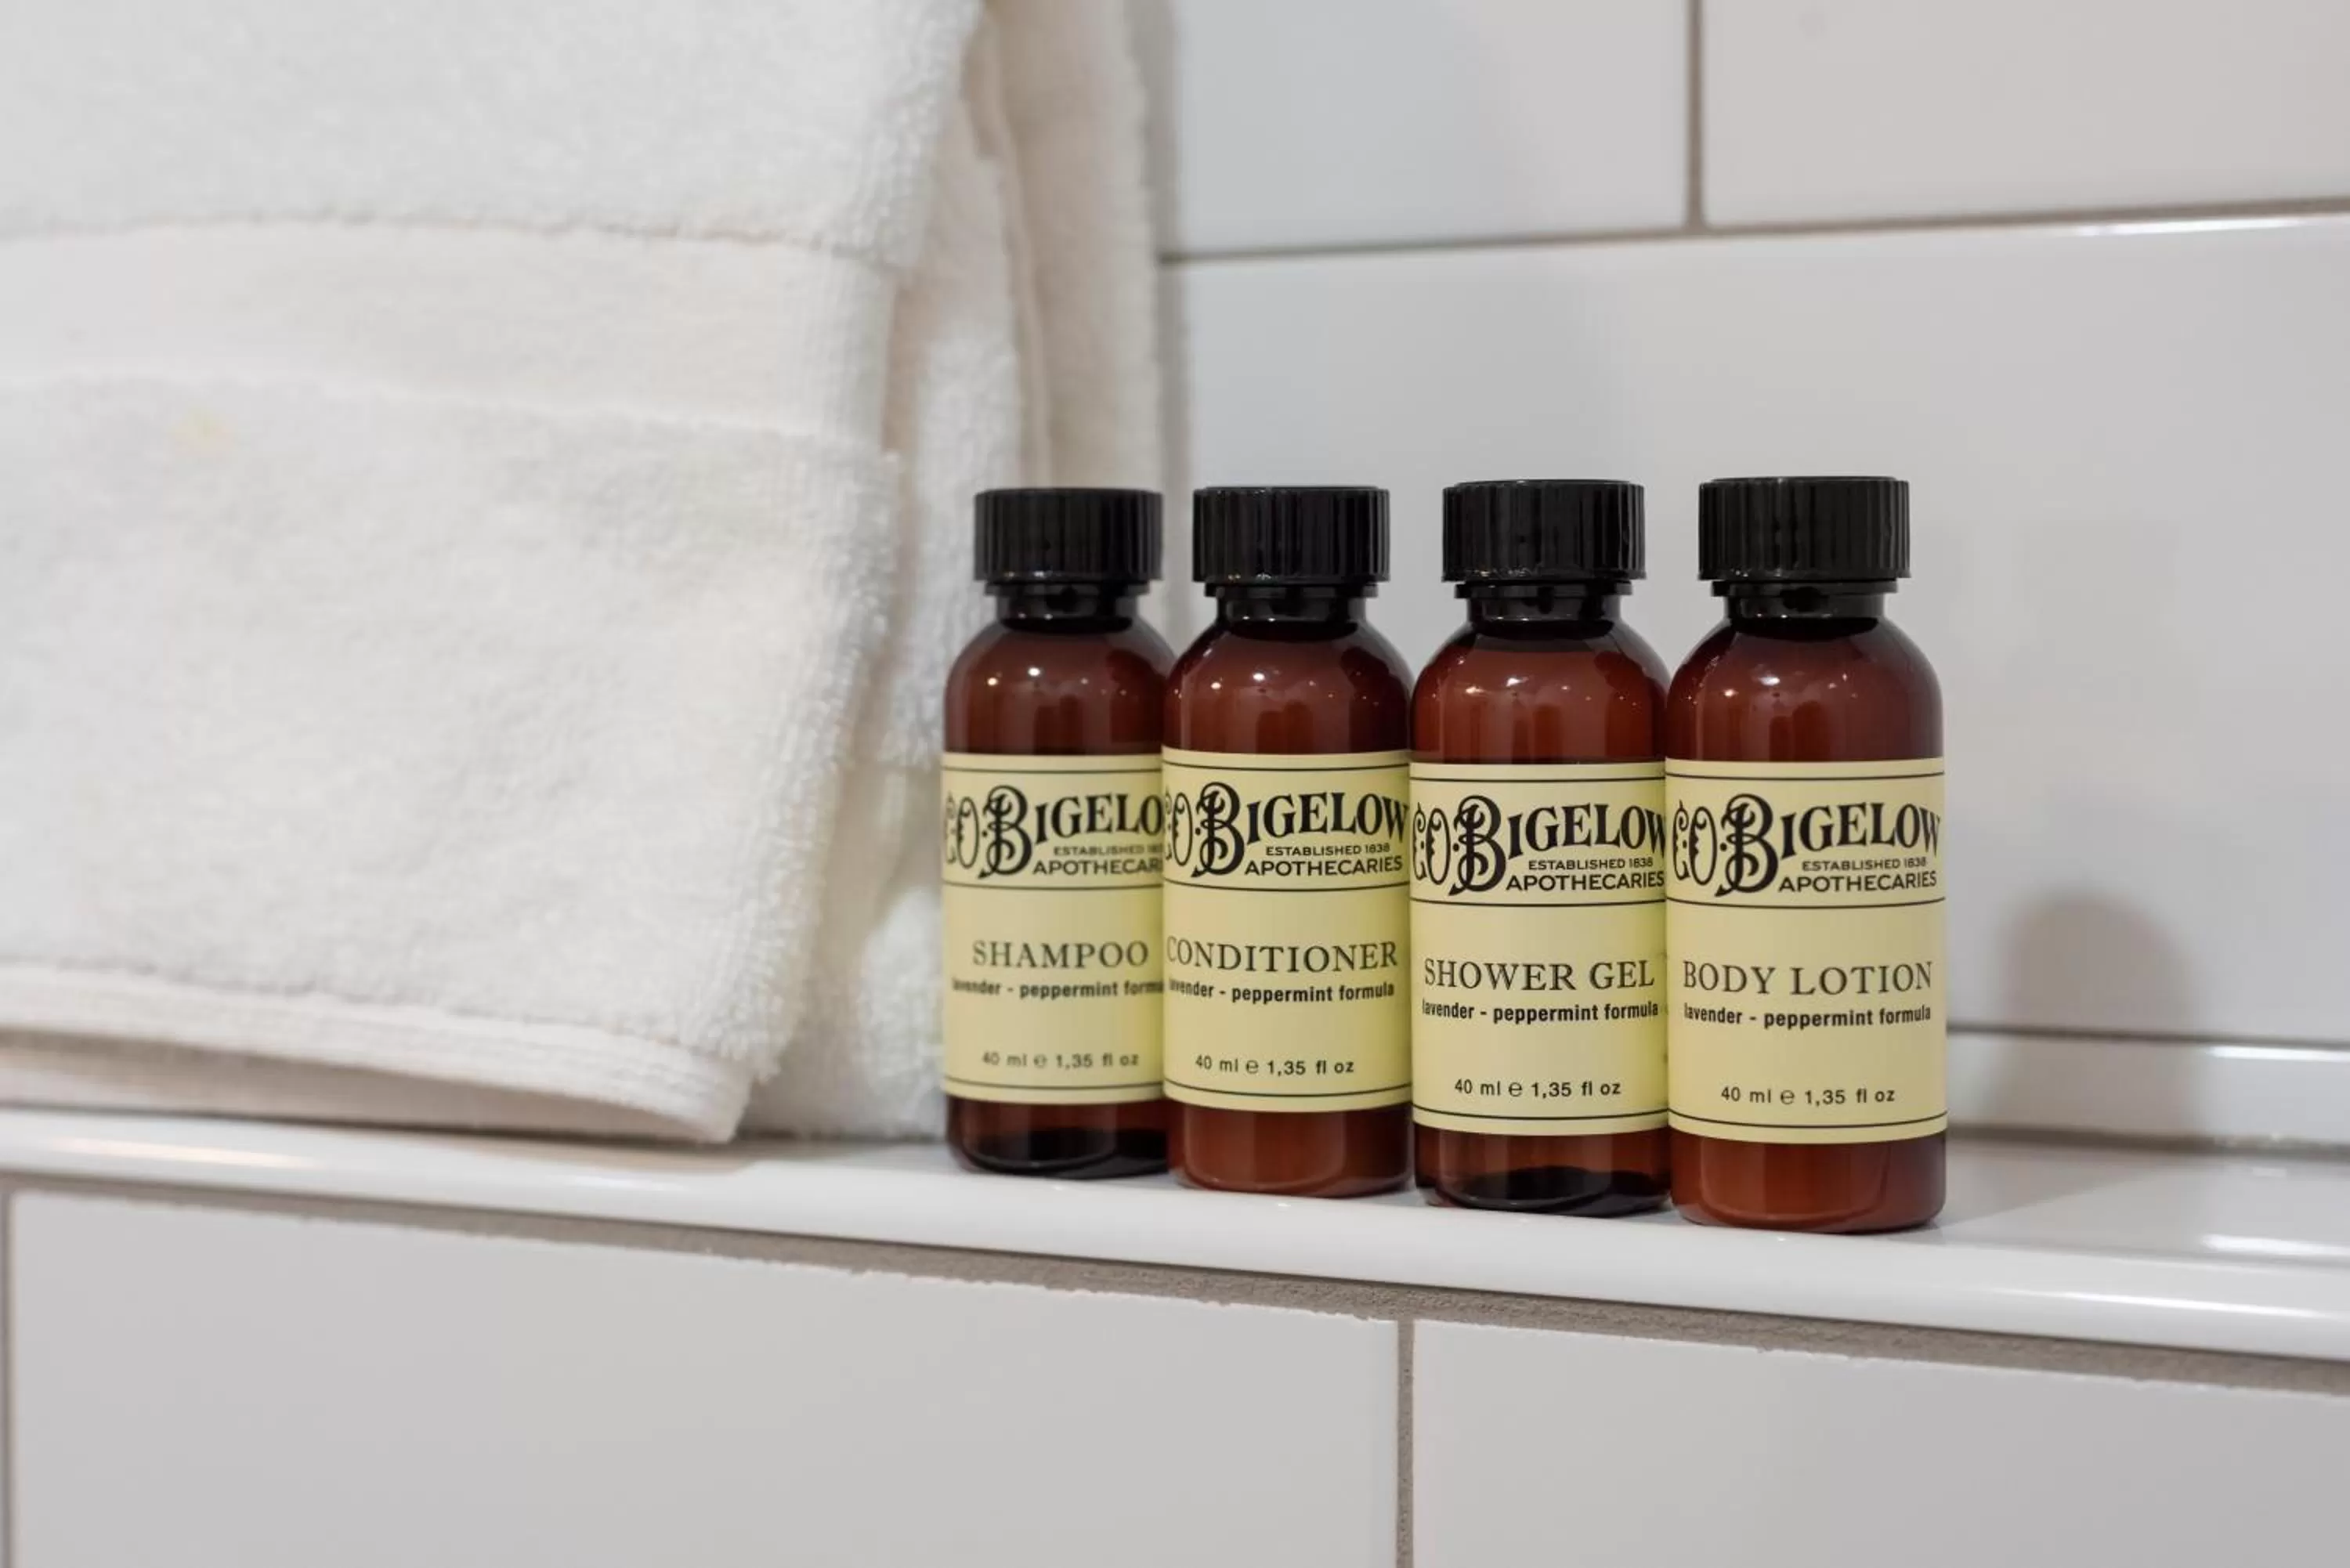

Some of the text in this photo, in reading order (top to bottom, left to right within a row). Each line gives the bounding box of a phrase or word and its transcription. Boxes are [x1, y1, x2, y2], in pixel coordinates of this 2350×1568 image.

[978, 785, 1164, 879] BIGELO
[1191, 782, 1408, 876] BIGELOW
[1266, 843, 1391, 856] ESTABLISHED 1838
[1448, 795, 1665, 896] BIGELOW
[1715, 793, 1941, 897] BIGELOW
[1244, 856, 1403, 876] APOTHECARIES
[1528, 856, 1654, 871] ESTABLISHED 1838
[1802, 859, 1901, 871] ESTABLISHED
[1506, 869, 1665, 891] APOTHECARIES
[1777, 869, 1937, 893] APOTHECARIES
[973, 940, 1149, 969] SHAMPOO
[1166, 936, 1398, 973] CONDITIONER
[1425, 958, 1655, 991] SHOWER GEL
[1683, 960, 1932, 995] BODY LOTION
[1019, 981, 1119, 1000] peppermint
[1231, 986, 1332, 1005] peppermint
[1339, 981, 1395, 1001] formula
[1423, 999, 1475, 1019] lavender
[1493, 1004, 1598, 1025] peppermint
[1604, 1001, 1659, 1021] formula
[1684, 1003, 1743, 1024] lavender
[1764, 1009, 1873, 1031] peppermint
[1879, 1004, 1930, 1025] formula
[982, 1051, 1000, 1065] 40
[1007, 1053, 1028, 1067] ml
[1101, 1053, 1113, 1067] fl
[1119, 1054, 1139, 1067] oz
[1195, 1054, 1213, 1071] 40
[1219, 1058, 1238, 1072] ml
[1316, 1060, 1327, 1075] fl
[1334, 1061, 1354, 1074] oz
[1455, 1078, 1473, 1094] 40
[1480, 1081, 1501, 1097] ml
[1581, 1081, 1593, 1097] fl
[1600, 1082, 1621, 1096] oz
[1721, 1086, 1741, 1102] 40
[1749, 1089, 1771, 1103] ml
[1856, 1088, 1867, 1103] fl
[1875, 1090, 1895, 1103] oz
